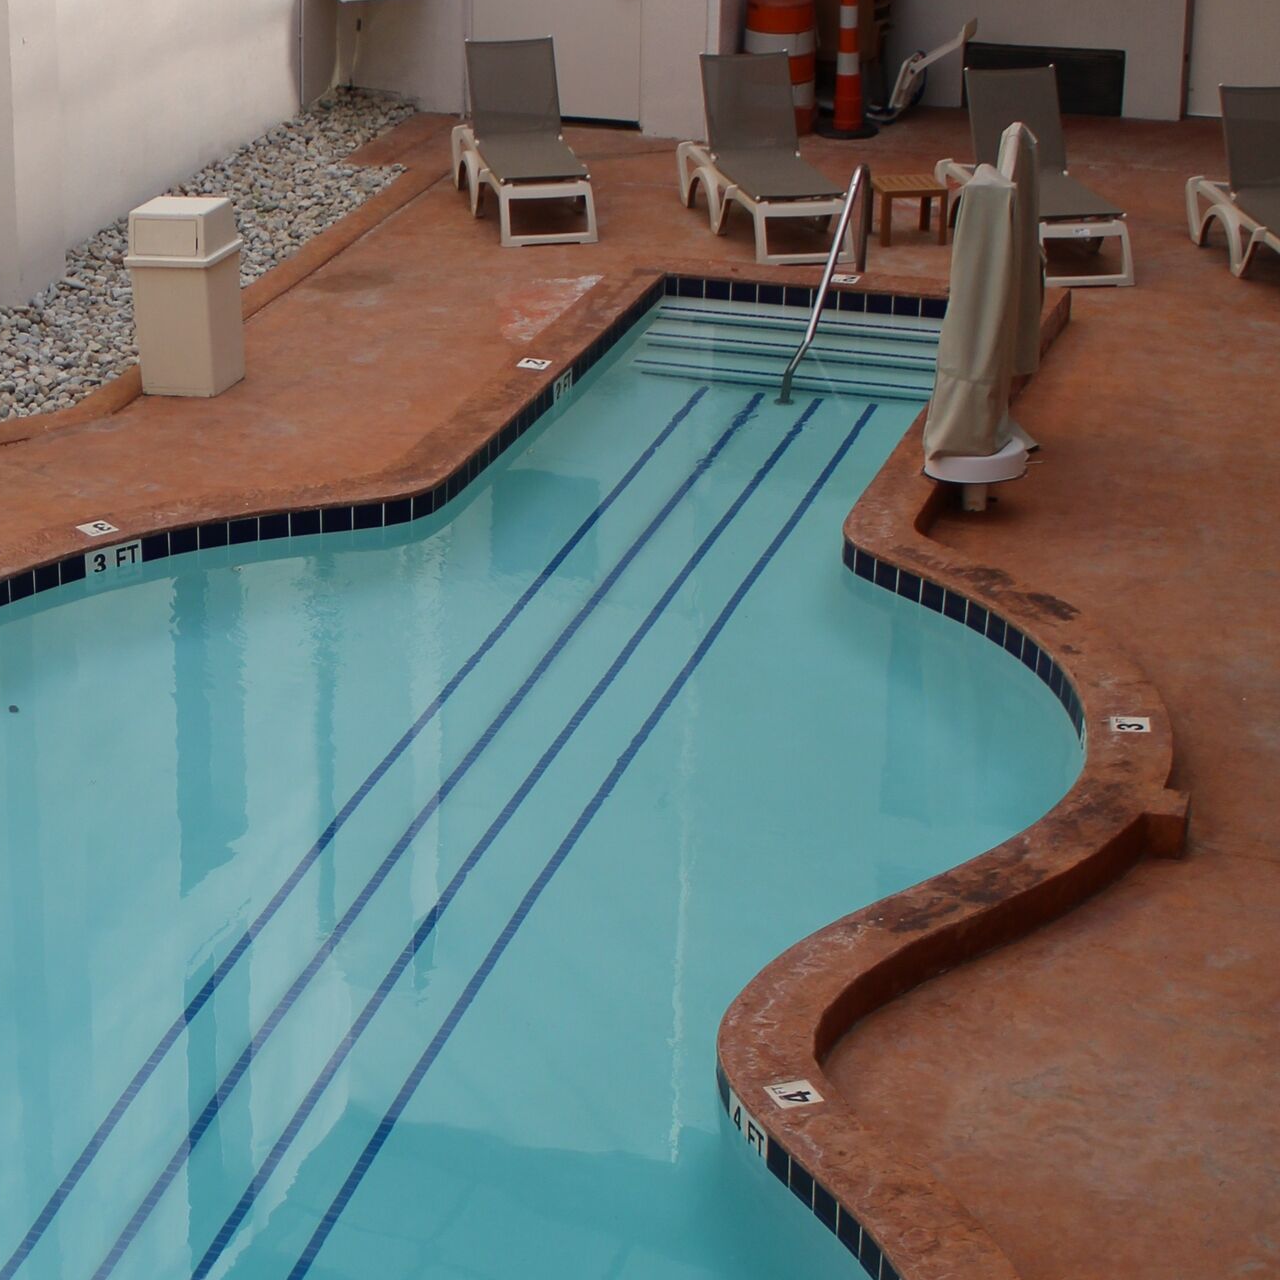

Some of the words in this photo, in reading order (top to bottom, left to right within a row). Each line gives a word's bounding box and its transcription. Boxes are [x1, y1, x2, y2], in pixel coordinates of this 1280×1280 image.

[93, 522, 112, 531] 3
[93, 553, 107, 573] 3
[116, 544, 139, 568] FT
[1116, 723, 1144, 731] 3
[779, 1090, 812, 1102] 4
[734, 1106, 741, 1131] 4
[748, 1120, 764, 1157] FT
